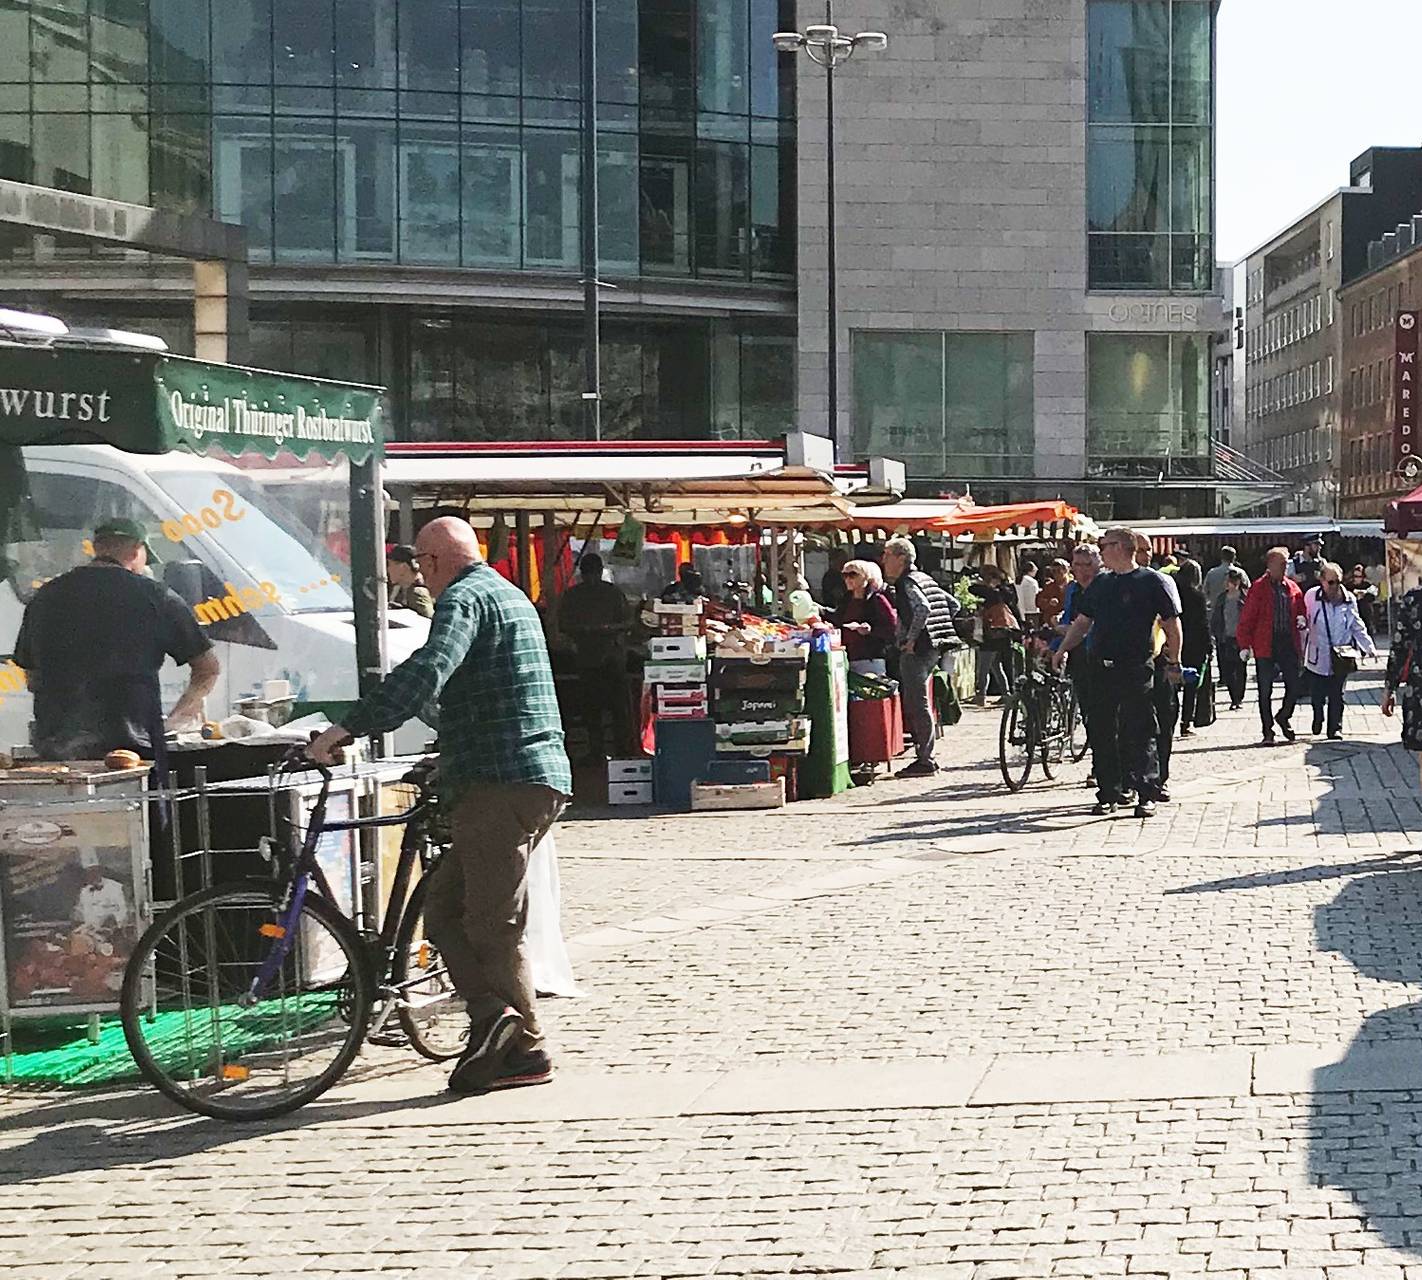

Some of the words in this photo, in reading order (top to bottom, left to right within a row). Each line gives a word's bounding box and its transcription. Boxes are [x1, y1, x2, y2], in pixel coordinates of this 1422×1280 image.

[0, 389, 112, 422] wurst
[170, 389, 230, 438] Original
[233, 397, 294, 445] Thüringer
[296, 405, 375, 444] Rostbratwurst
[1399, 352, 1415, 454] MAREDO
